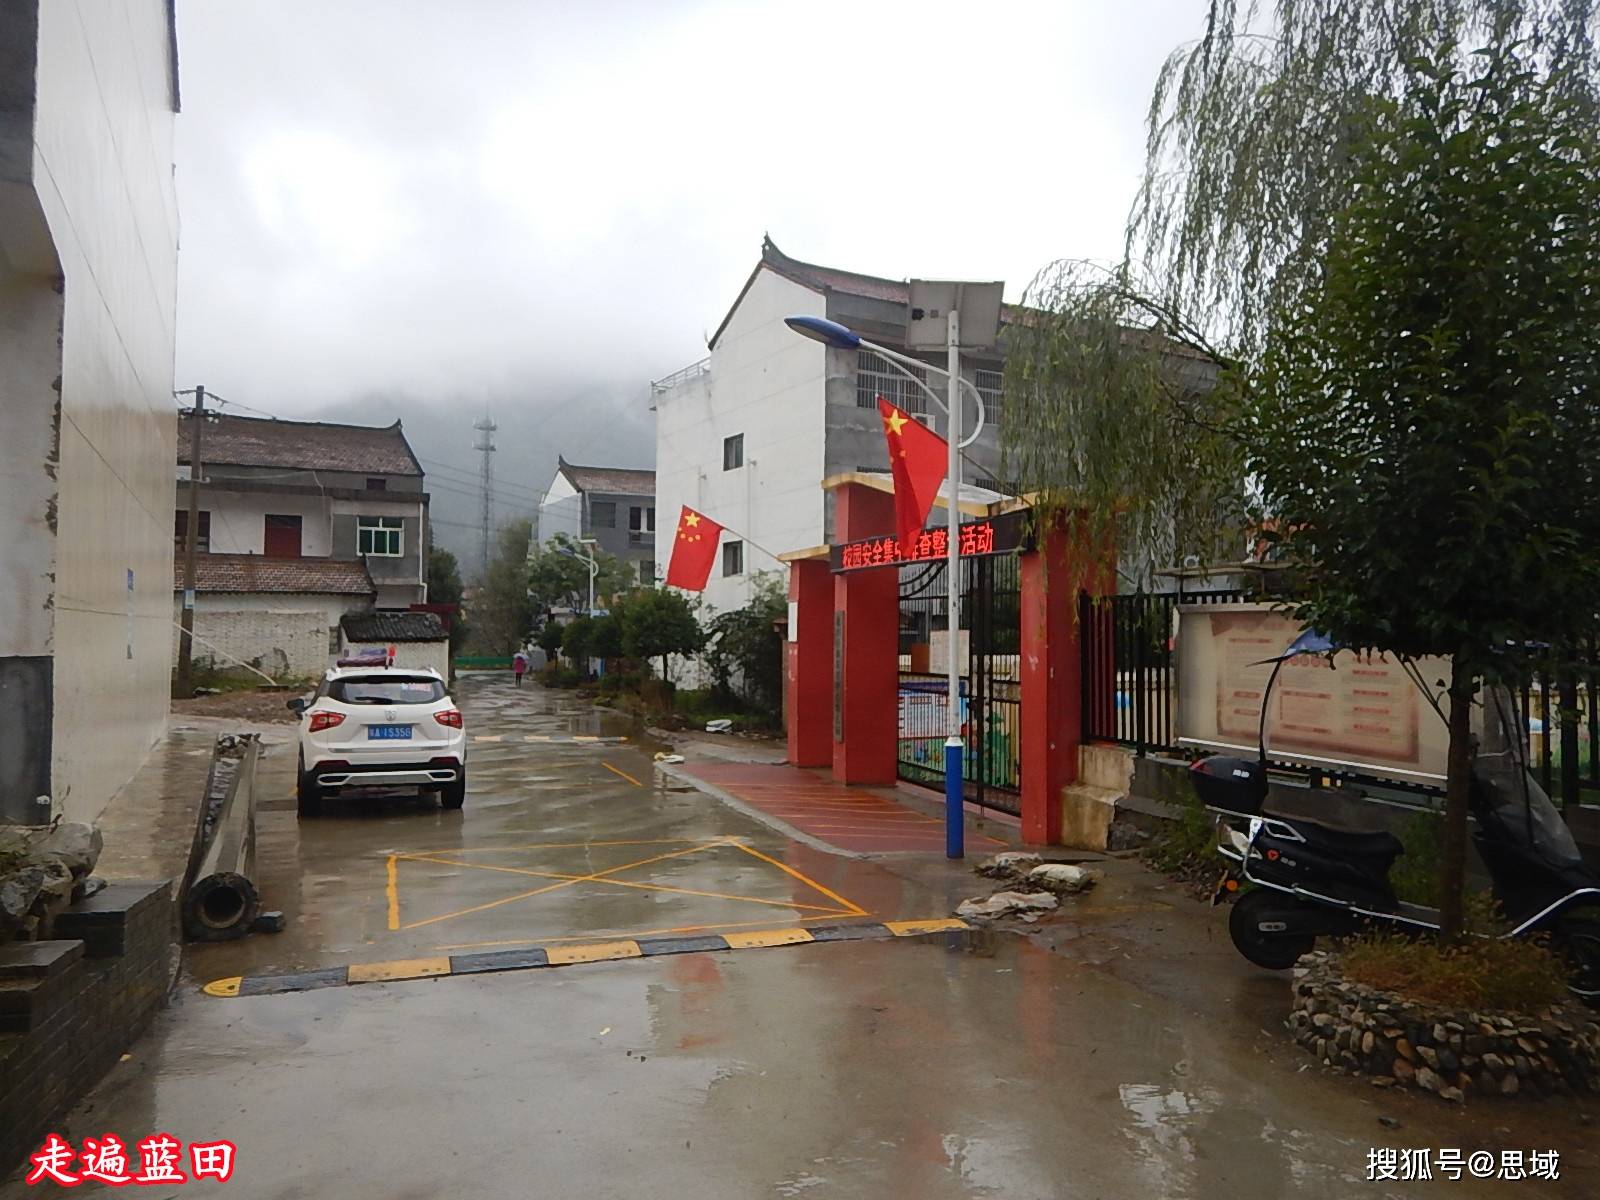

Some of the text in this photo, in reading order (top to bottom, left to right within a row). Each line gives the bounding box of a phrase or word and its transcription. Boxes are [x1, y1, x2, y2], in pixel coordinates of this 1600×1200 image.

[842, 520, 994, 569] 校园安全集查整活动
